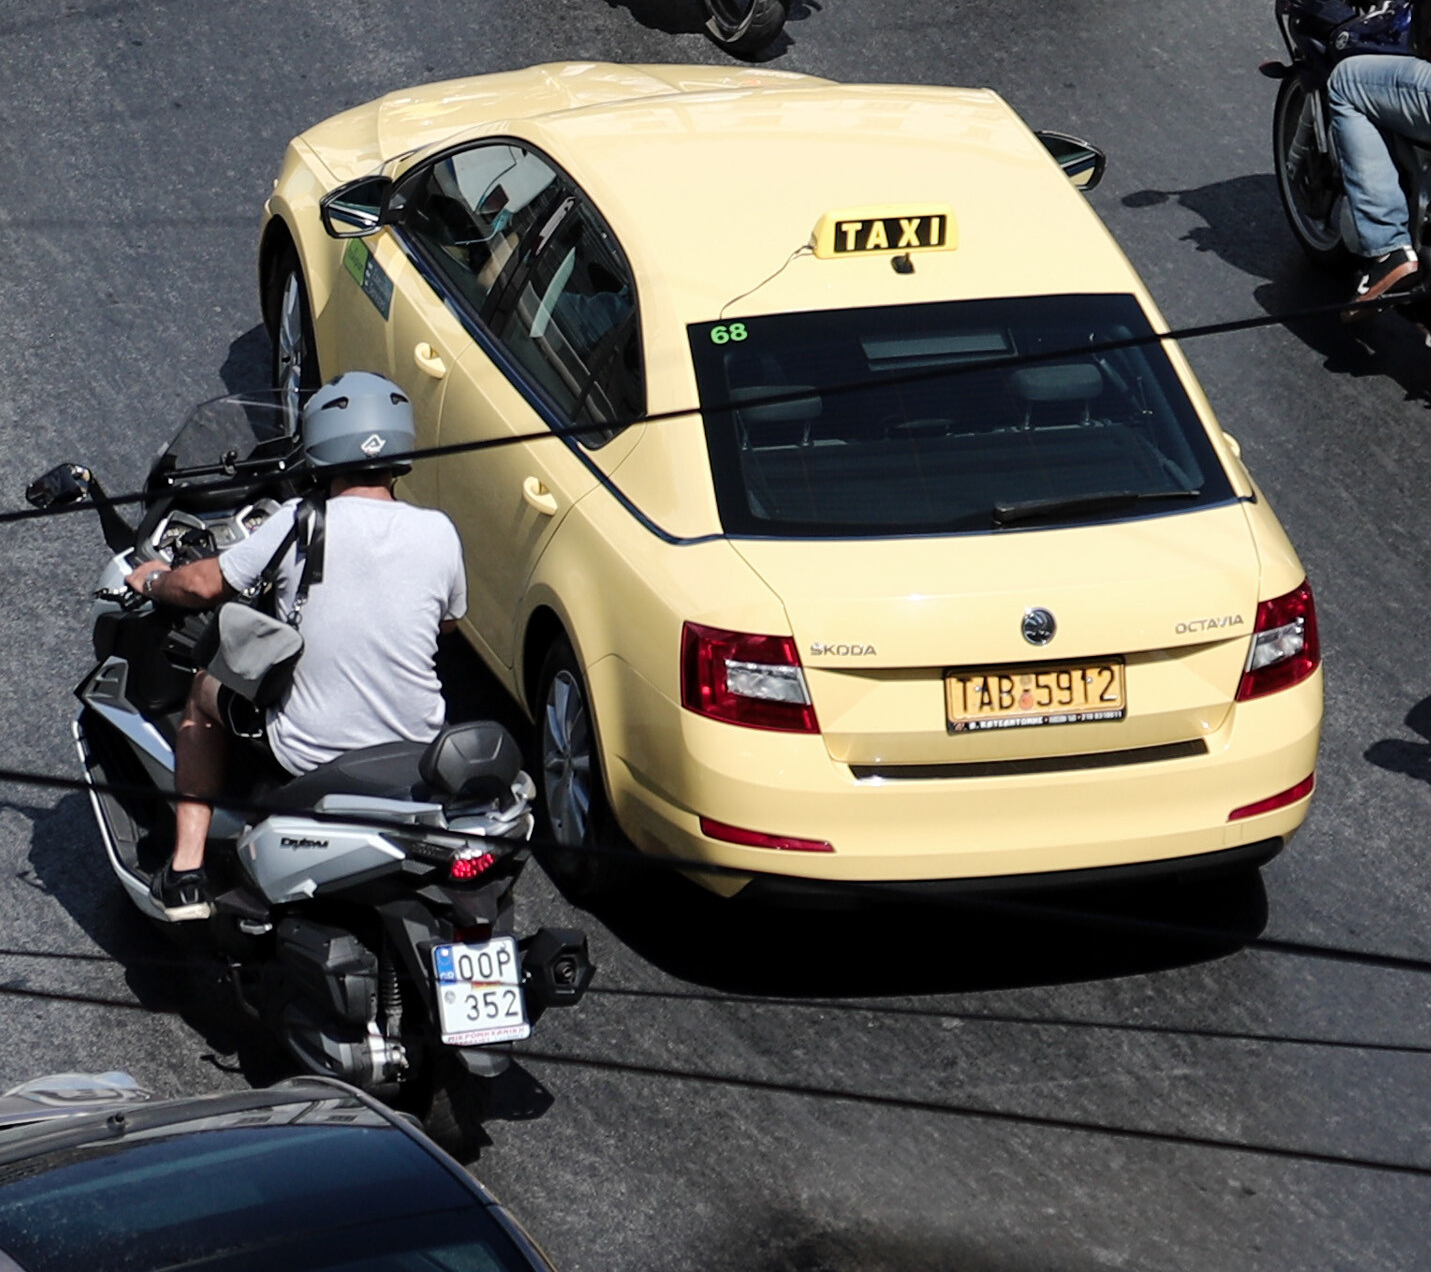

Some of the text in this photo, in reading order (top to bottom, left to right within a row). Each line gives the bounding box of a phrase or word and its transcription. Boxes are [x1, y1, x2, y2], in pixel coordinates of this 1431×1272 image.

[841, 217, 941, 250] TAXI
[710, 323, 748, 344] 68
[1175, 614, 1244, 634] OCTAVIA
[810, 643, 877, 656] ŠKODA
[956, 667, 1118, 713] TAB-5912
[465, 990, 519, 1021] 352
